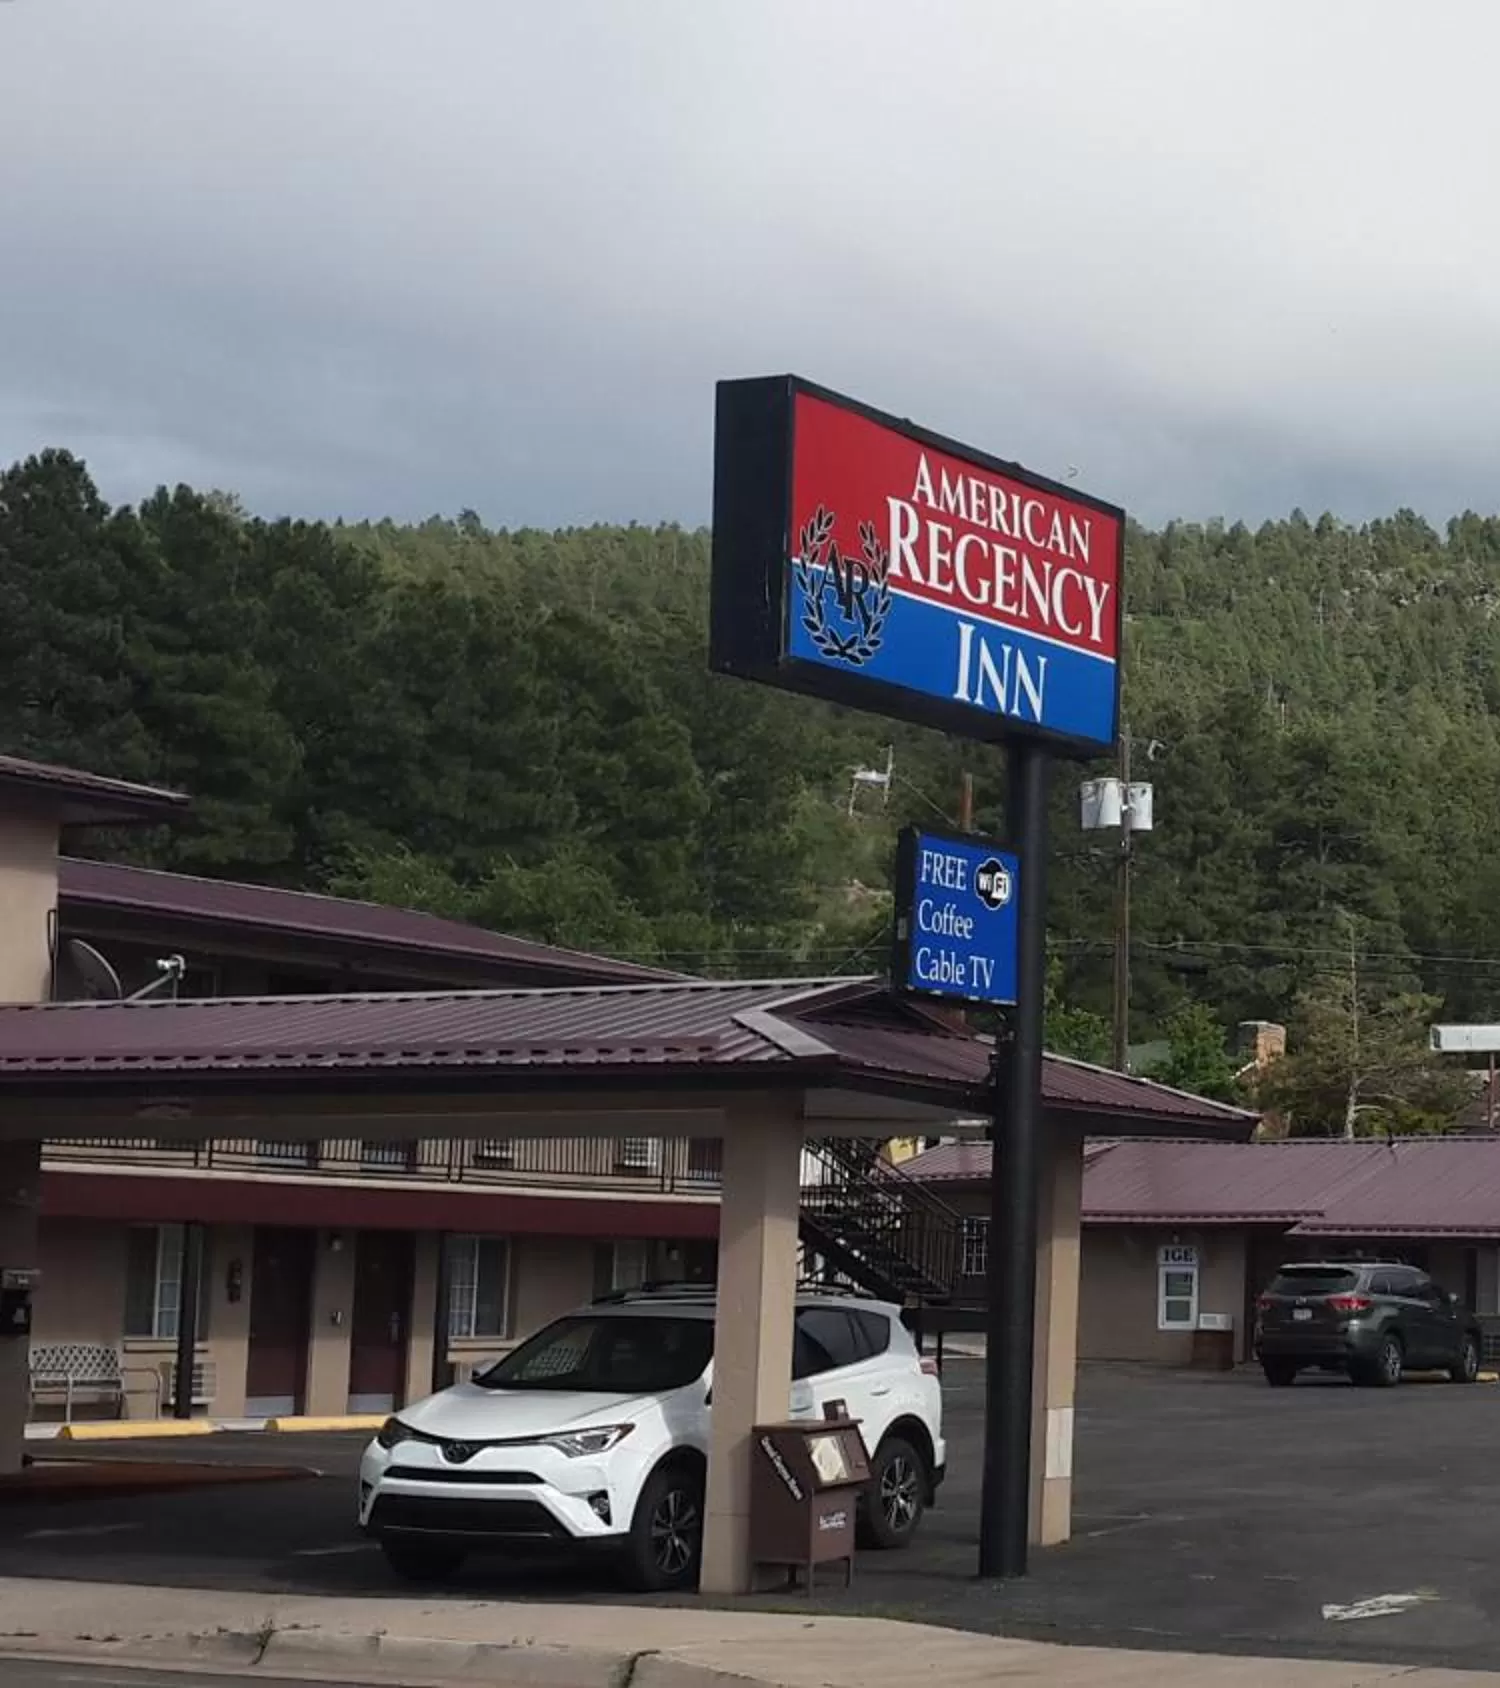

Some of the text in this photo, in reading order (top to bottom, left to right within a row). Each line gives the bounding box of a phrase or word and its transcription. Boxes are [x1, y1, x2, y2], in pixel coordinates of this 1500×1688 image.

[911, 452, 1091, 565] AMERICAN
[886, 496, 1110, 643] REGENCY
[953, 620, 1048, 724] INN
[920, 850, 968, 890] FREE
[919, 899, 974, 939] Coffee
[916, 947, 995, 989] Cable TV
